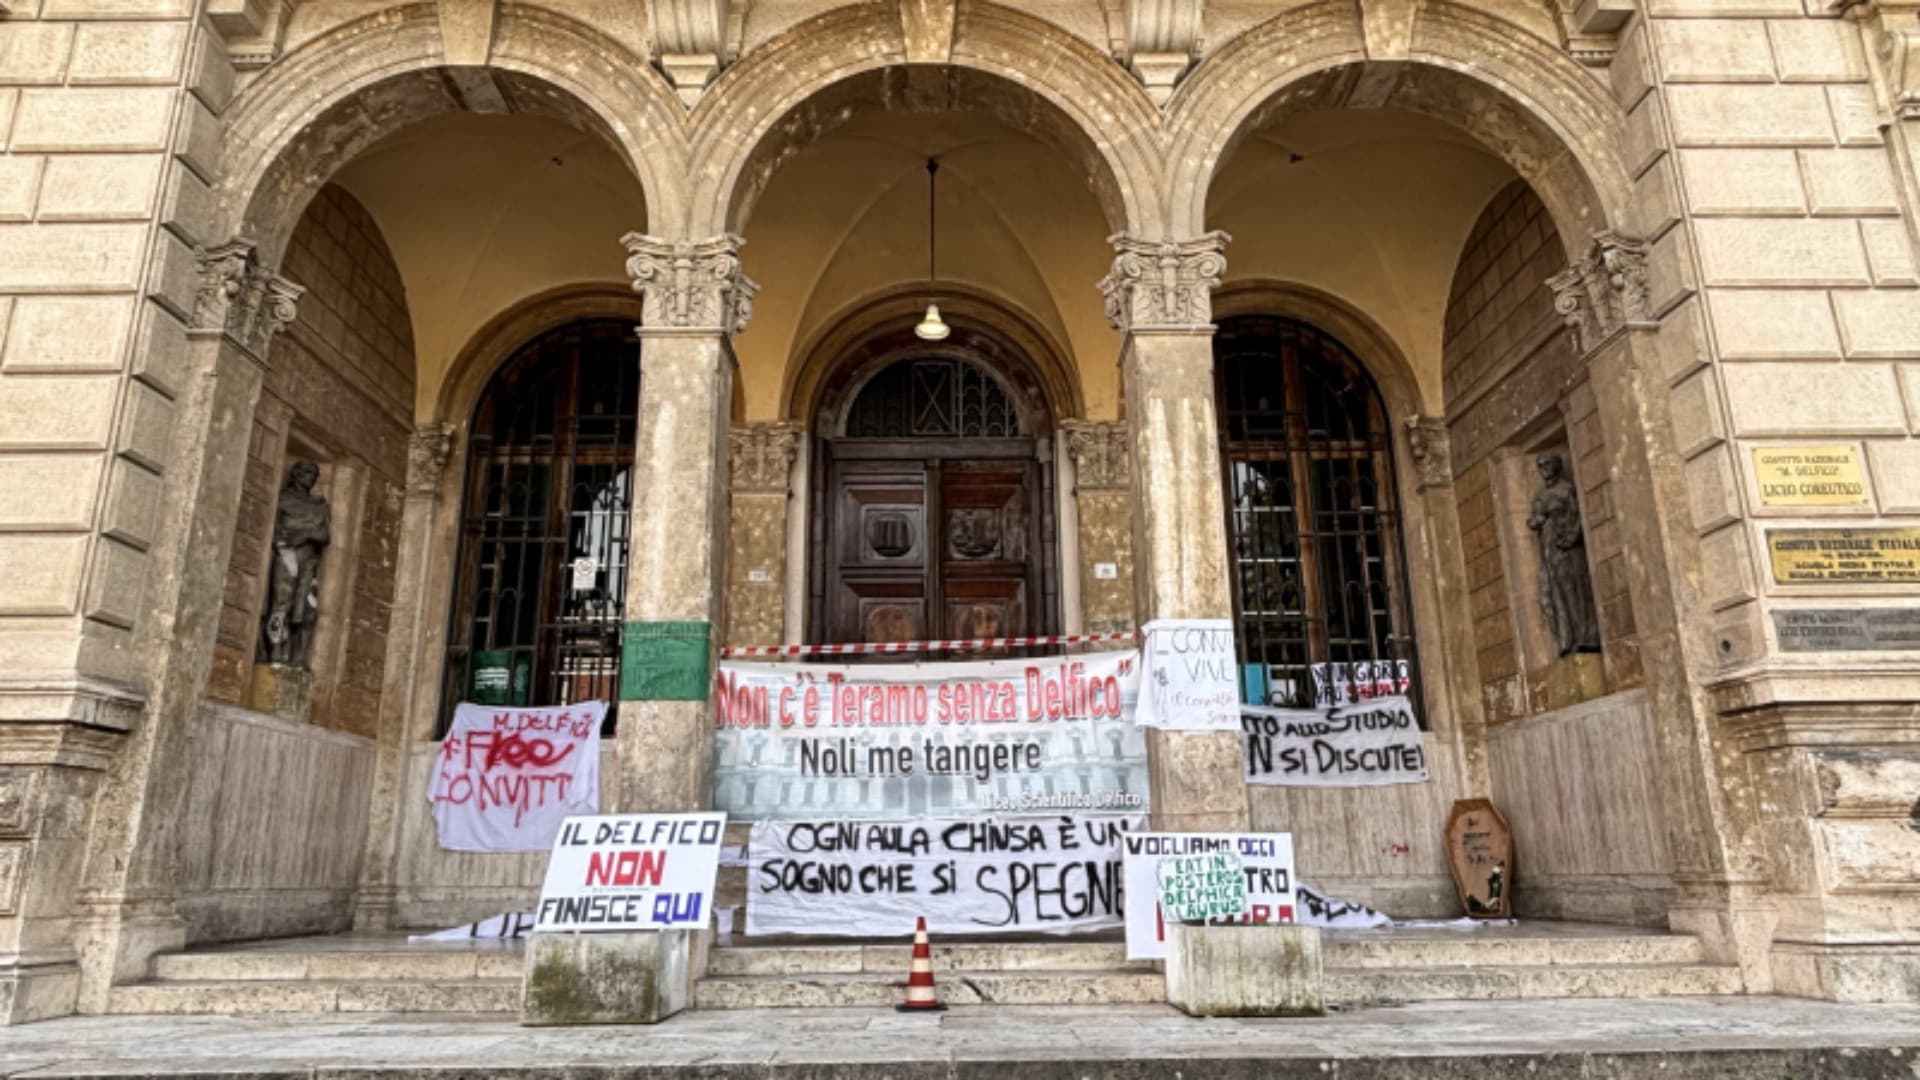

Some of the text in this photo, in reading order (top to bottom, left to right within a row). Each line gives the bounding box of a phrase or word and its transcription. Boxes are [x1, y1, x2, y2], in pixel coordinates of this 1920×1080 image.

[1763, 481, 1863, 497] LICEO COREUTICO
[715, 671, 770, 728] Non
[827, 671, 929, 727] Teramo
[937, 681, 1018, 724] senza
[800, 738, 1042, 783] Noli me tangere
[1279, 748, 1308, 774] SI
[560, 820, 722, 846] IL DELFICO
[866, 825, 930, 856] AULA
[585, 850, 667, 887] NON
[760, 859, 851, 893] SOGNO
[858, 864, 917, 894] CHE
[538, 892, 703, 924] FINISCE QUI
